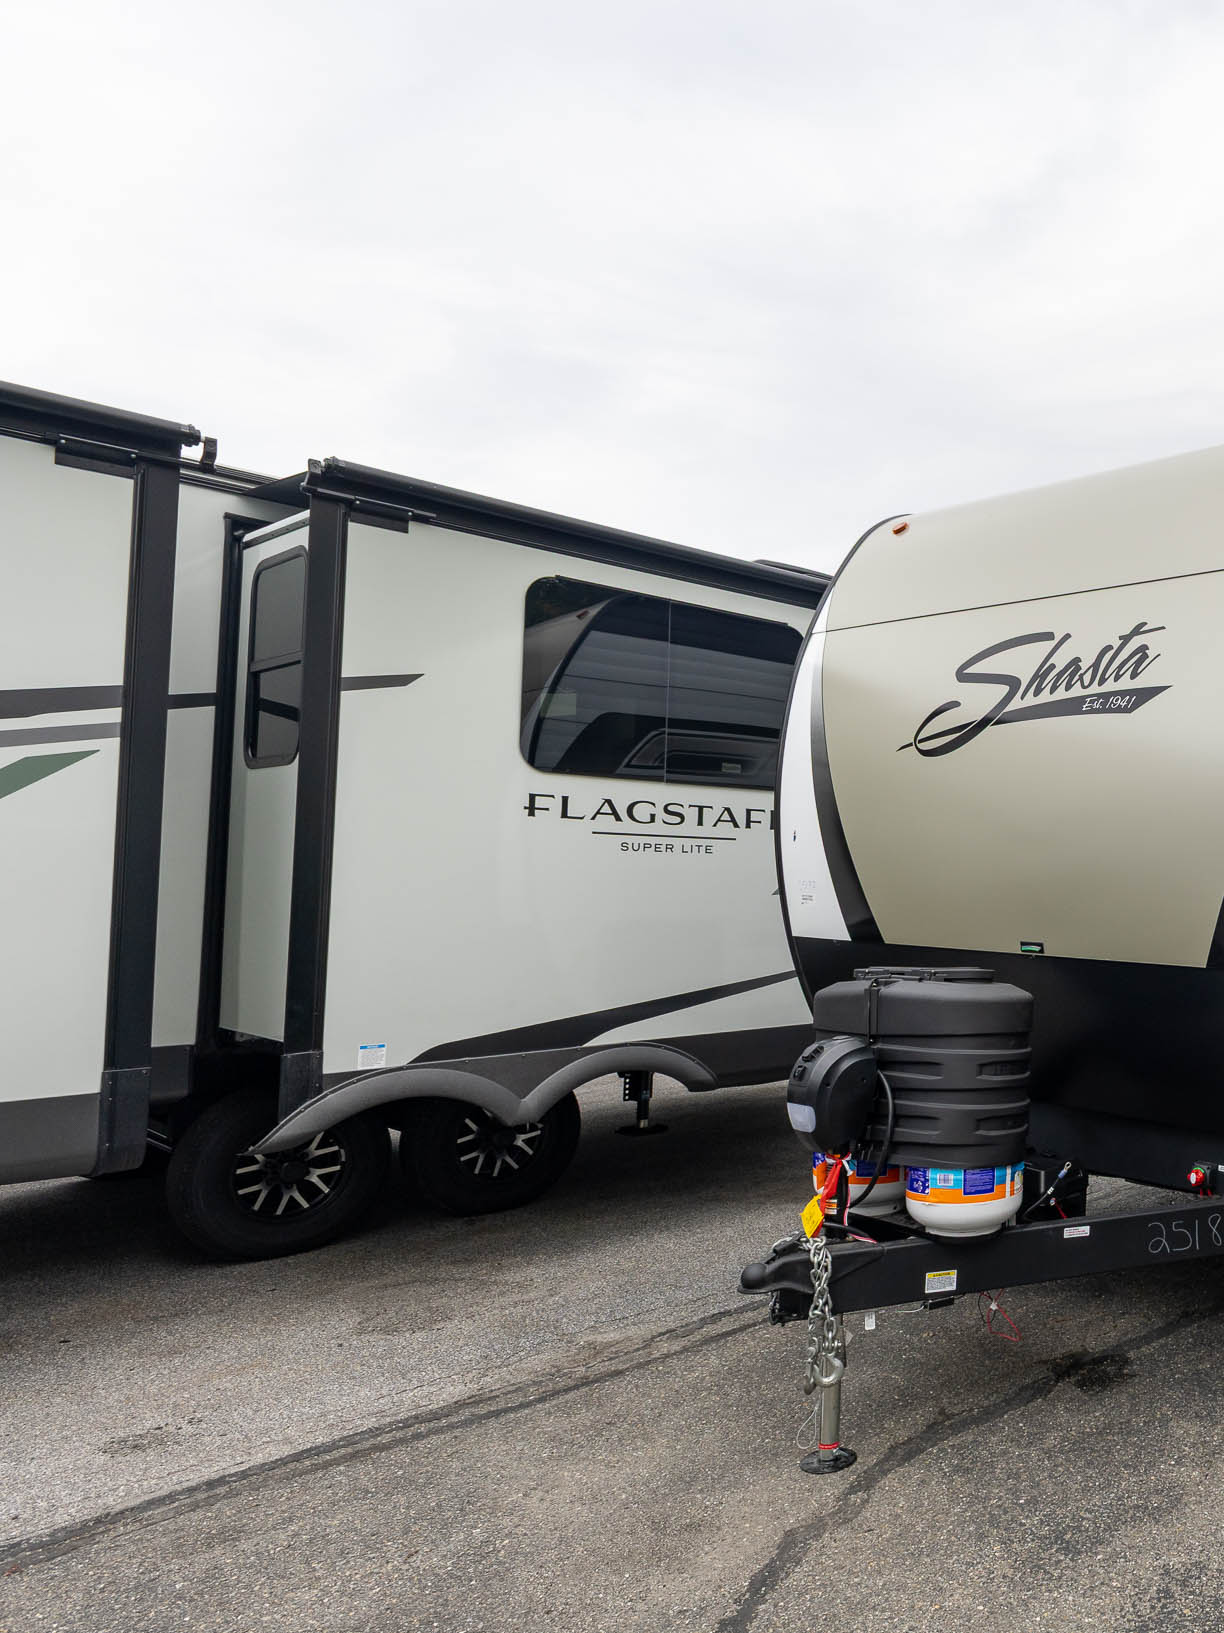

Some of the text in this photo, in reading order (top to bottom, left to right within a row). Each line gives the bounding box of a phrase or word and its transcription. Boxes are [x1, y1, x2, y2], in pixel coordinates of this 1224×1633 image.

[908, 621, 1168, 758] Shasta
[1081, 695, 1137, 711] Est. 1941
[523, 792, 775, 830] FLAGSTAF
[620, 841, 714, 854] SUPER LITE
